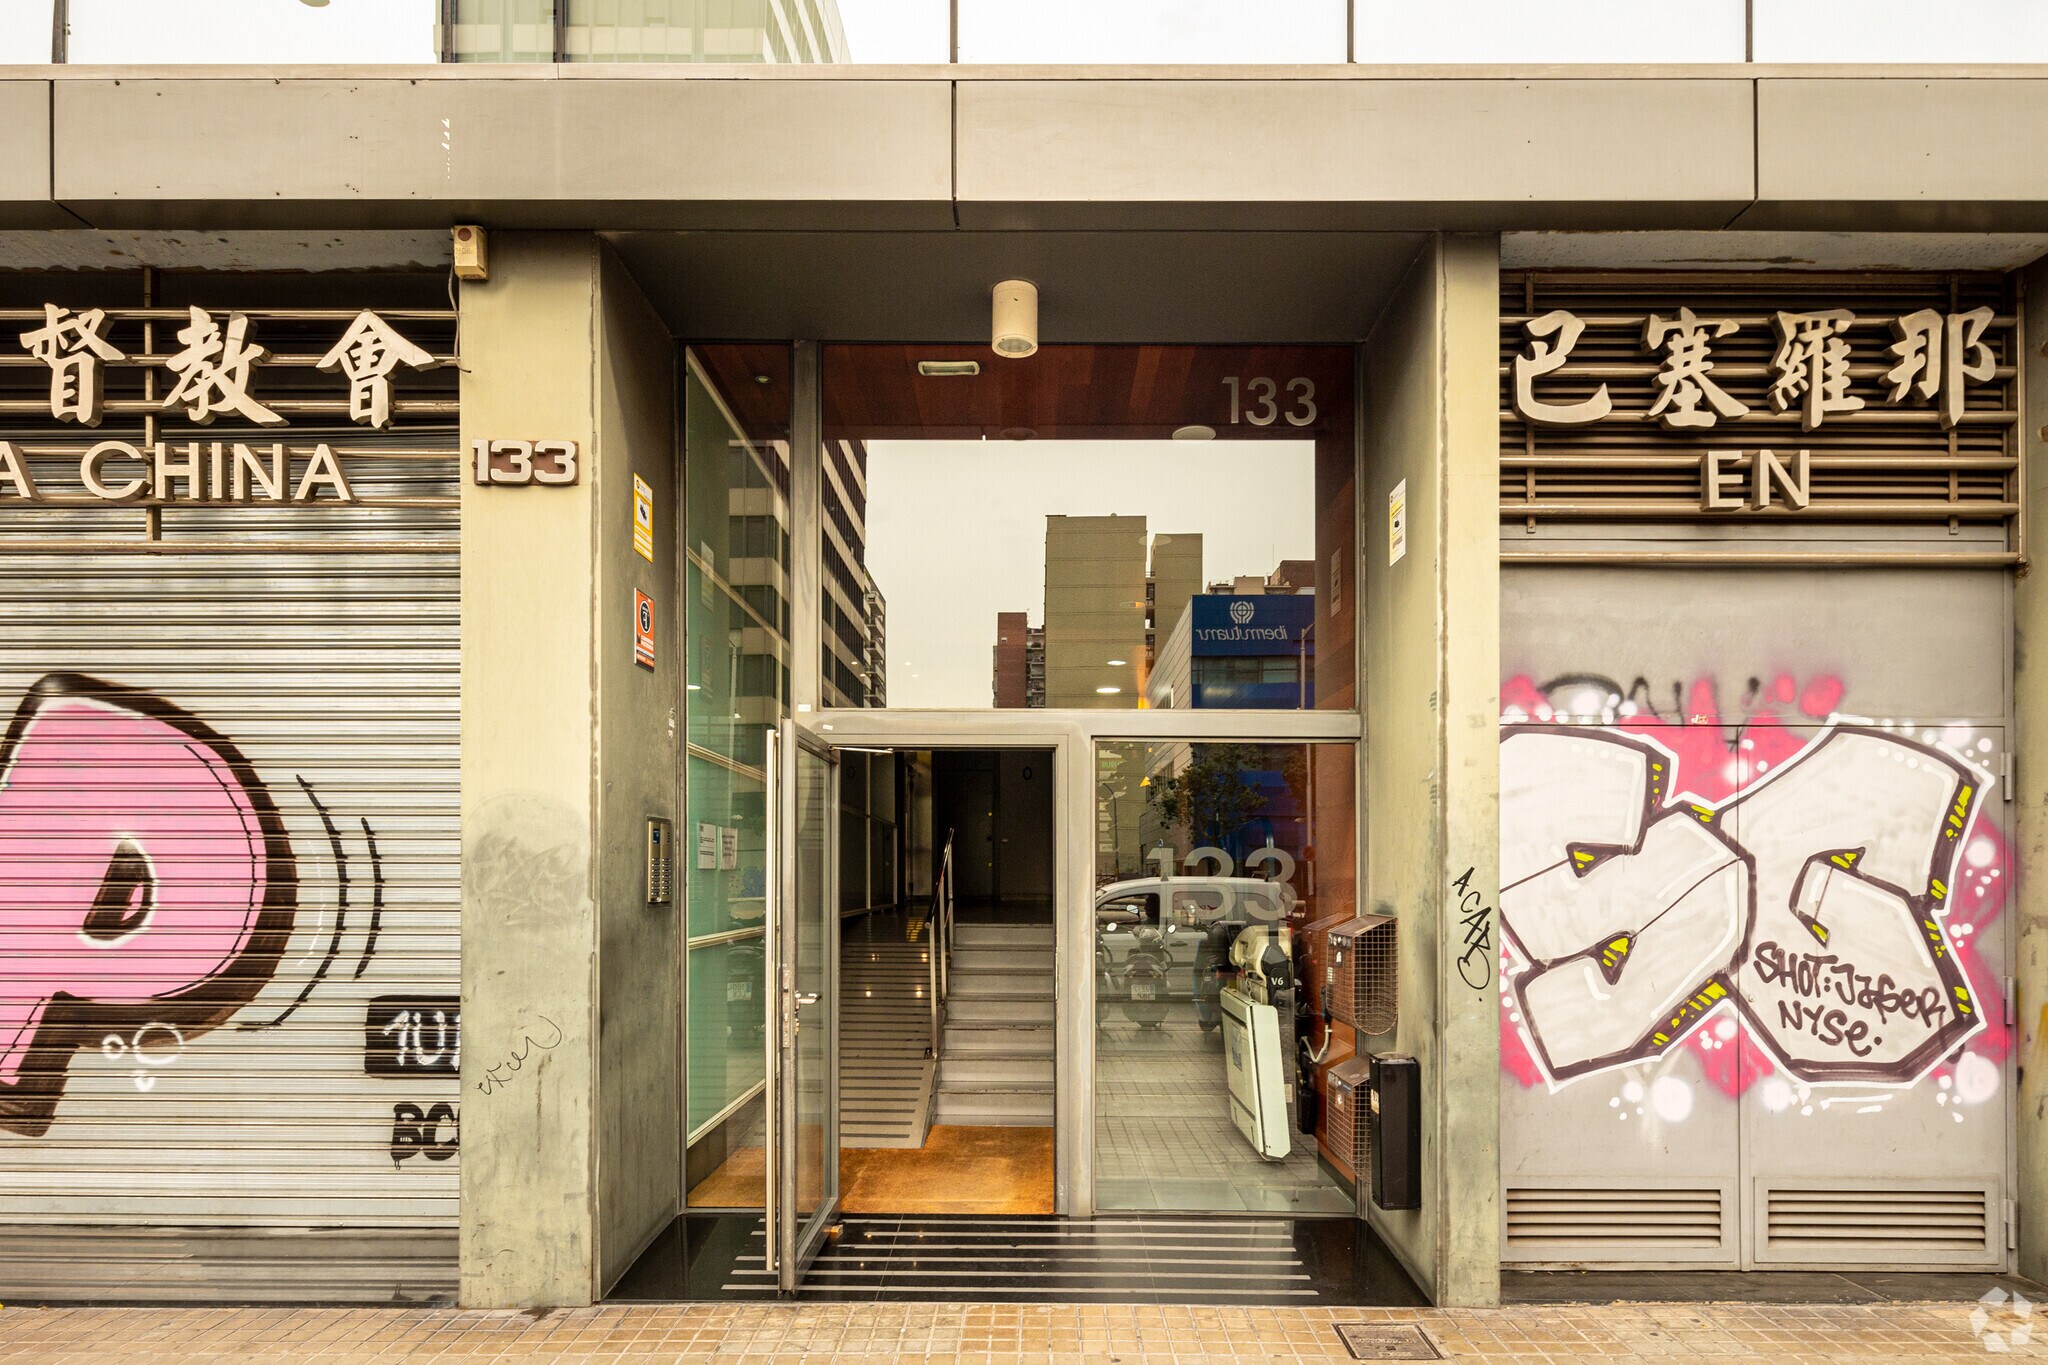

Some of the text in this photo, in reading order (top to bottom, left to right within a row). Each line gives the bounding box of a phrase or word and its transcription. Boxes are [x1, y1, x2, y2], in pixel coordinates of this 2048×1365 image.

[1222, 376, 1317, 427] 133
[80, 440, 357, 501] CHINA
[472, 438, 577, 484] 133
[1701, 449, 1811, 511] EN
[1146, 846, 1298, 921] 133
[1270, 976, 1284, 986] V6
